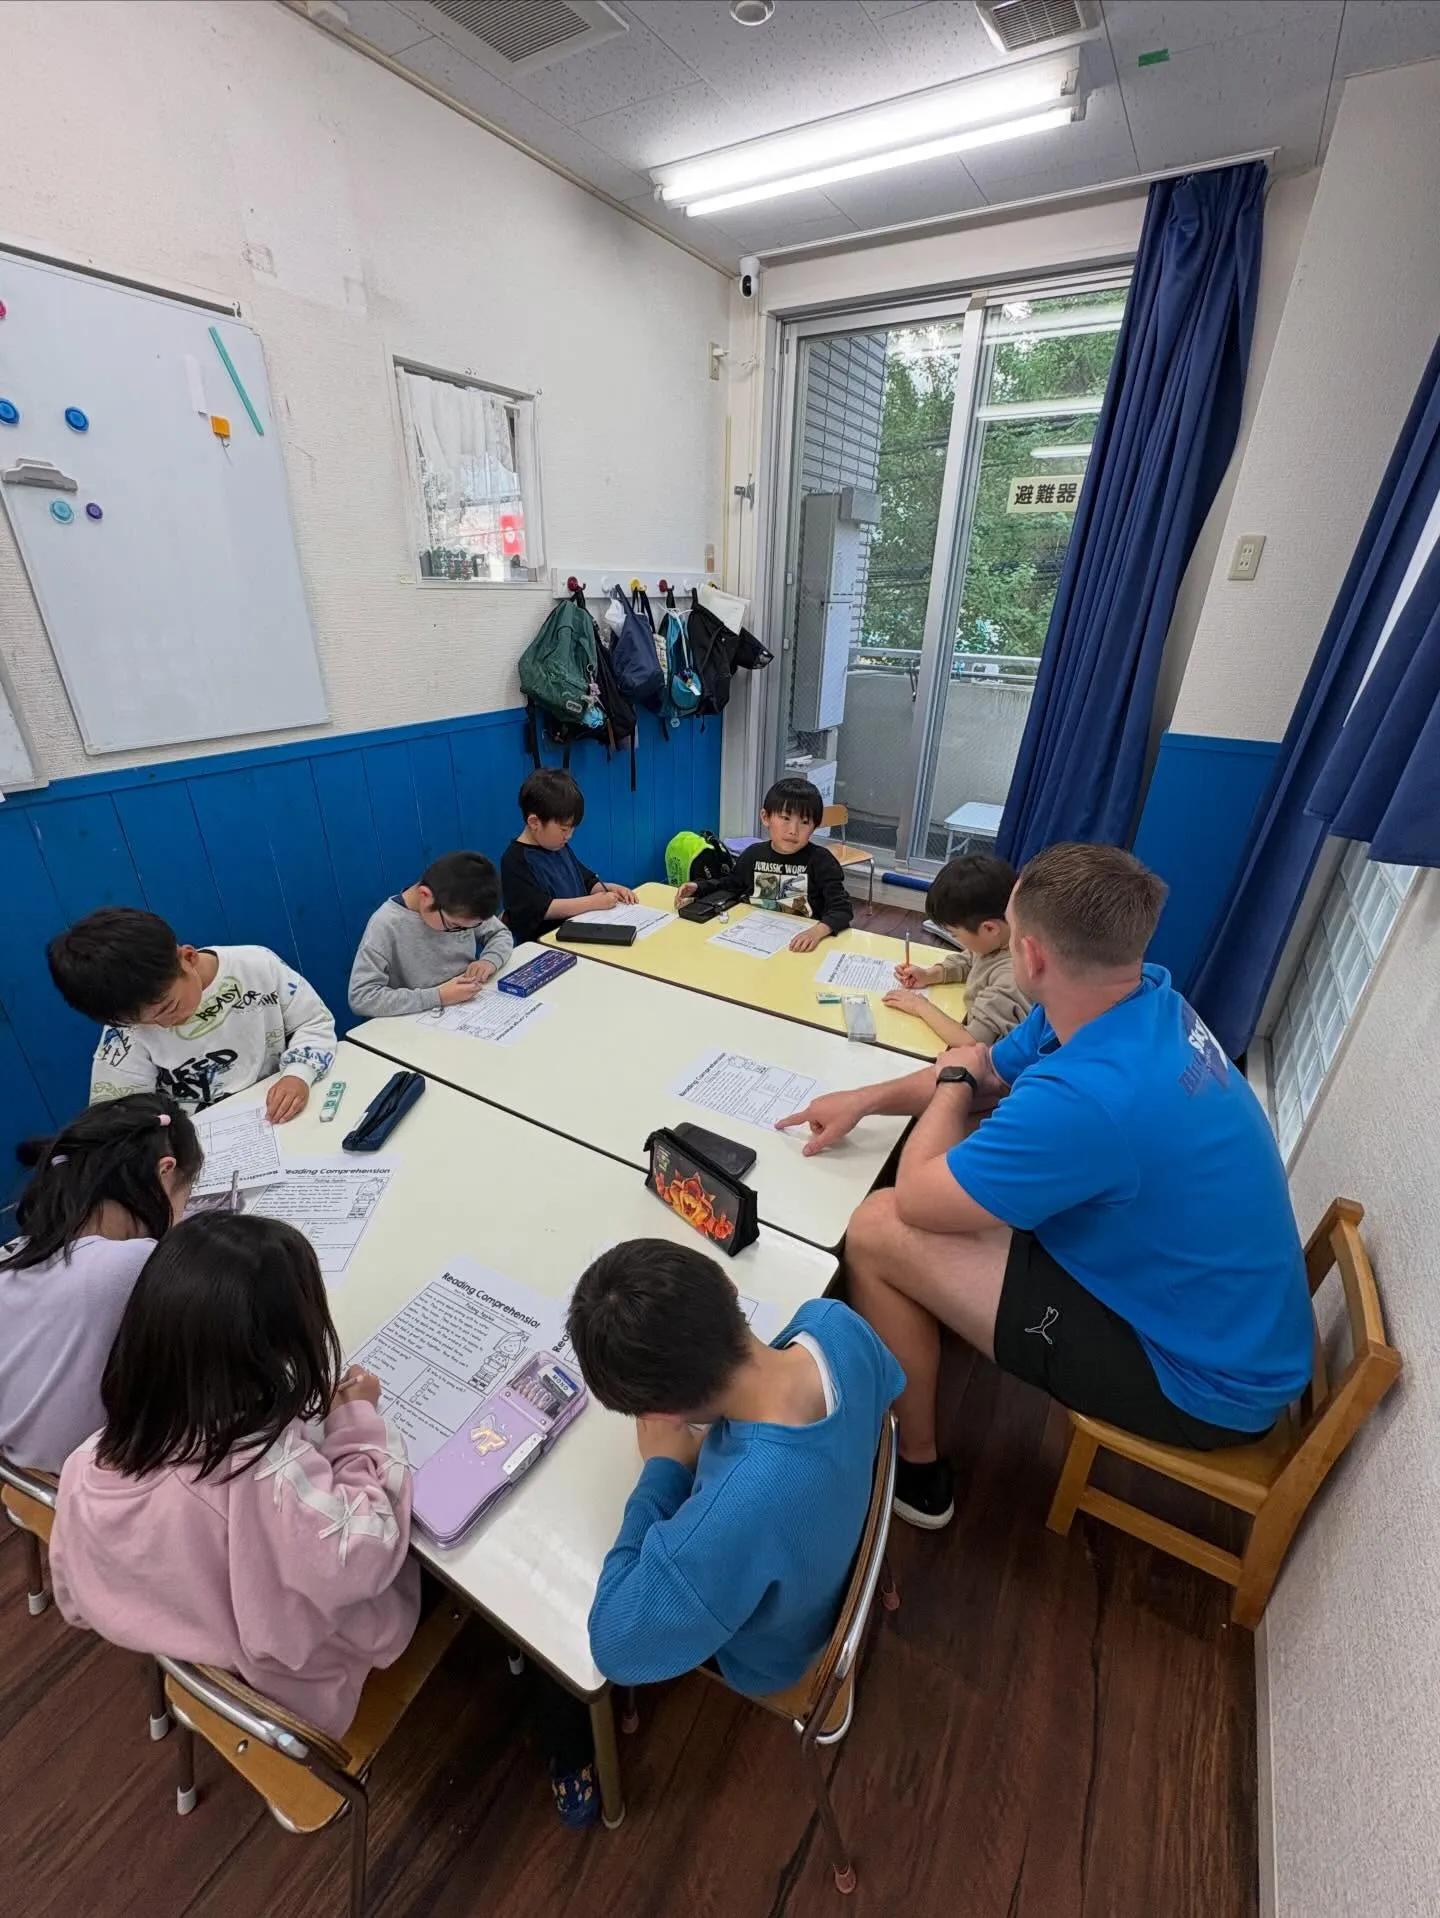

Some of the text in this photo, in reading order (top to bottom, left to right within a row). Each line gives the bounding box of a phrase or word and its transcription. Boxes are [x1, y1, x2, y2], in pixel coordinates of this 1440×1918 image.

[1014, 483, 1078, 505] 避難器
[754, 861, 783, 874] JURASSIC
[195, 984, 242, 1022] READY
[232, 990, 261, 1010] FOR
[285, 1168, 318, 1176] eading
[441, 1272, 476, 1295] Reading
[552, 1374, 569, 1392] MONO
